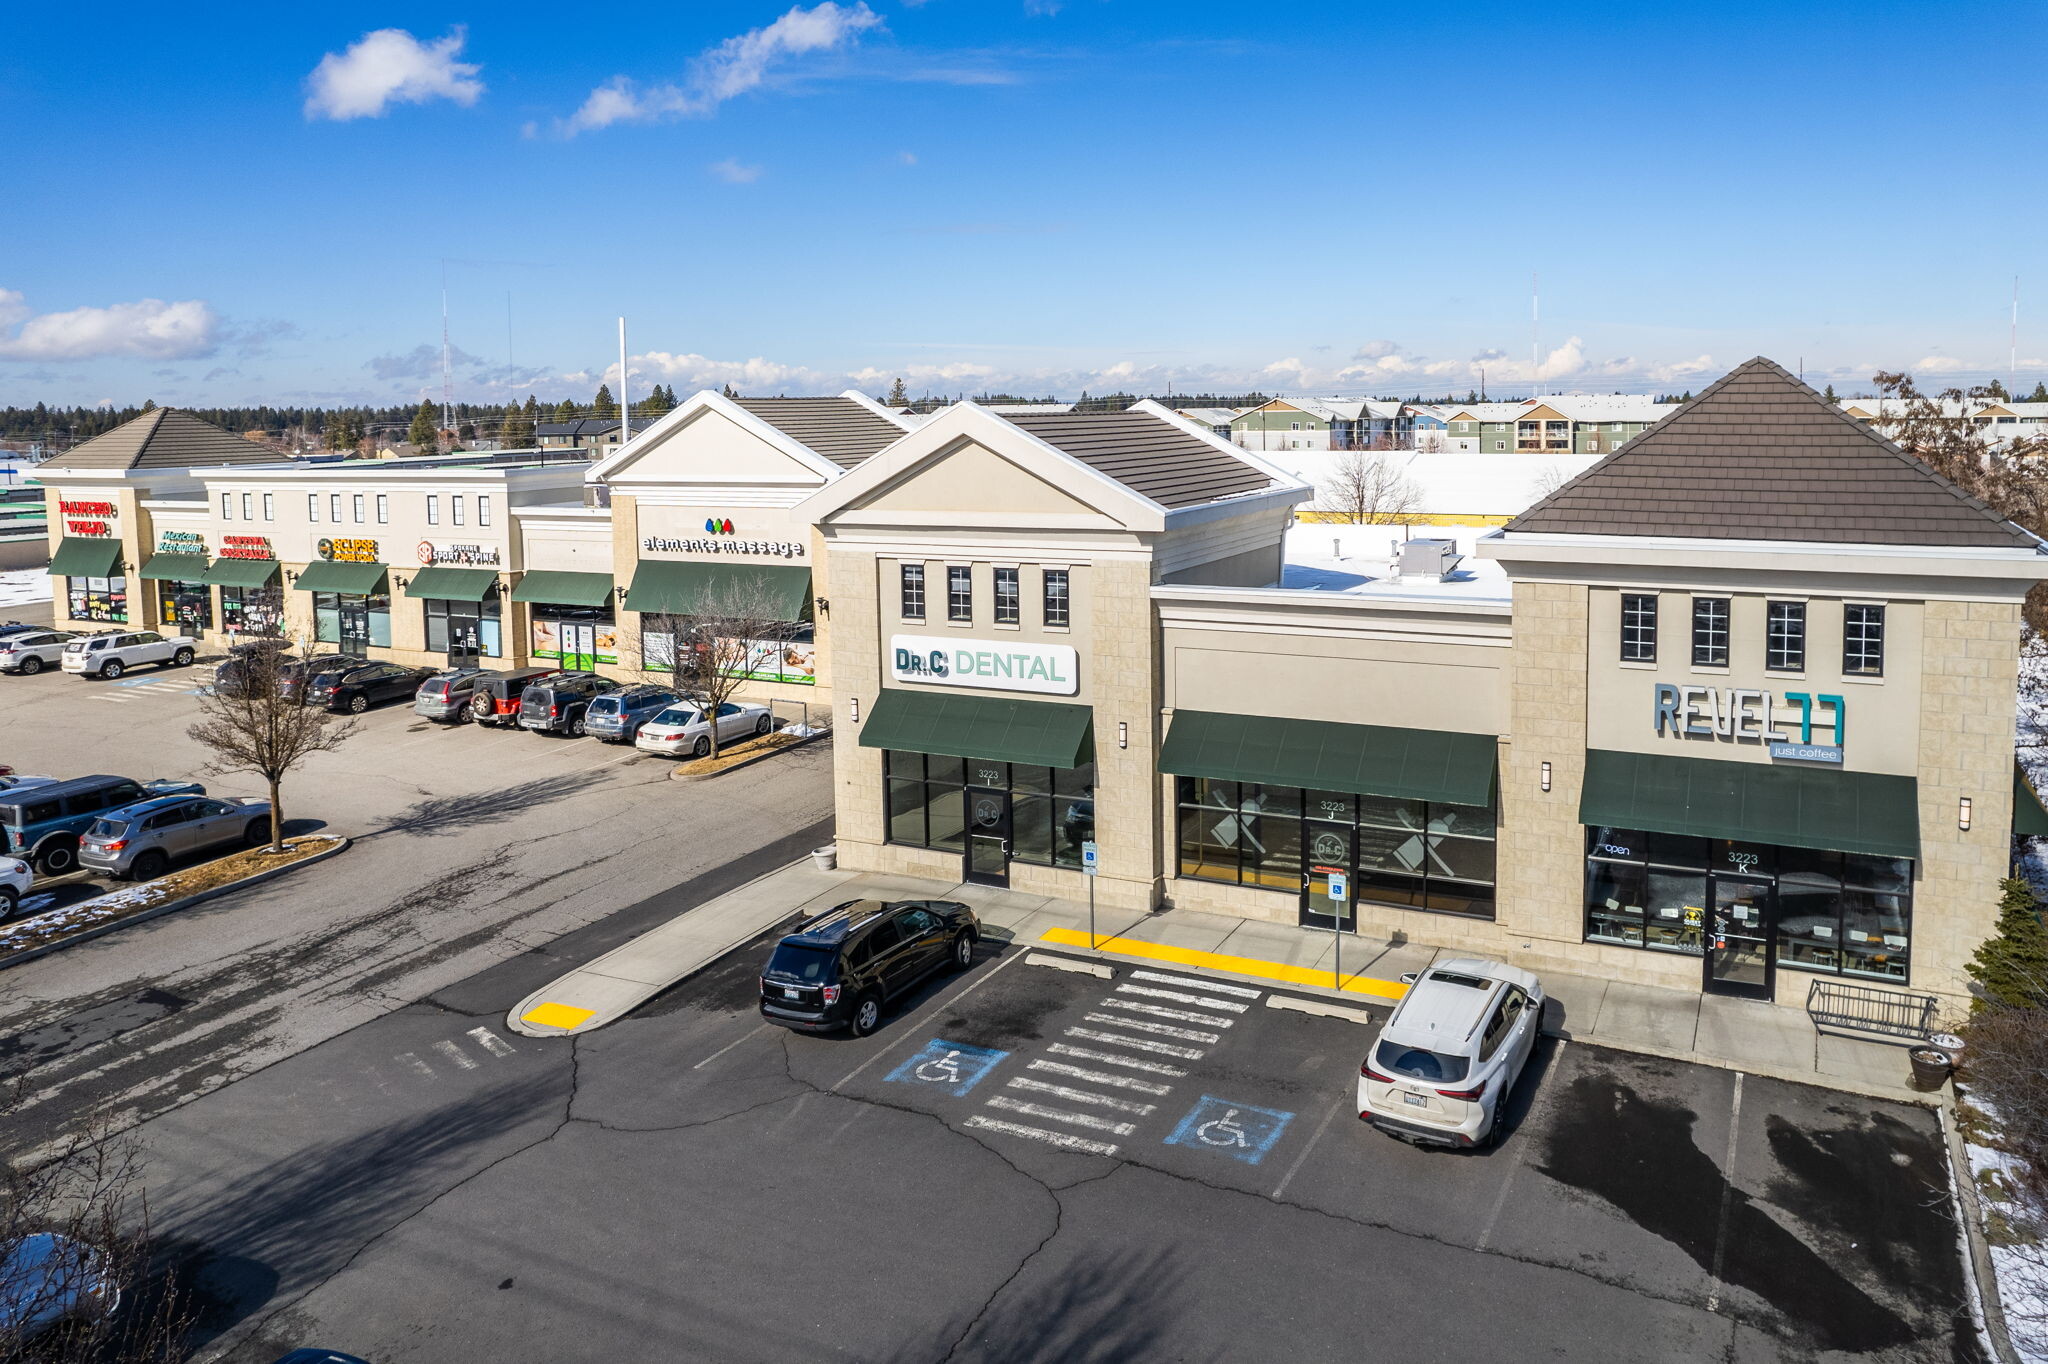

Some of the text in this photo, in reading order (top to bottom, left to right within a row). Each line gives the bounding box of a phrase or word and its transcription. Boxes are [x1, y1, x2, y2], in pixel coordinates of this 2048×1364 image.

[58, 501, 112, 515] RANCHO
[162, 531, 198, 541] Mexican
[159, 542, 202, 553] Restaurant
[333, 538, 375, 552] ECLIPSE
[450, 544, 477, 552] SPOKANE
[642, 537, 802, 556] elements massage
[334, 553, 374, 562] POWER YOGA
[433, 551, 494, 561] SPORT SPINE
[955, 650, 1067, 682] DENTAL
[1774, 746, 1837, 760] just coffee
[978, 769, 999, 779] 3223
[1320, 800, 1345, 812] 3223
[1328, 811, 1334, 820] J
[1605, 844, 1630, 856] open
[1728, 852, 1758, 865] 3223
[1739, 863, 1748, 874] K
